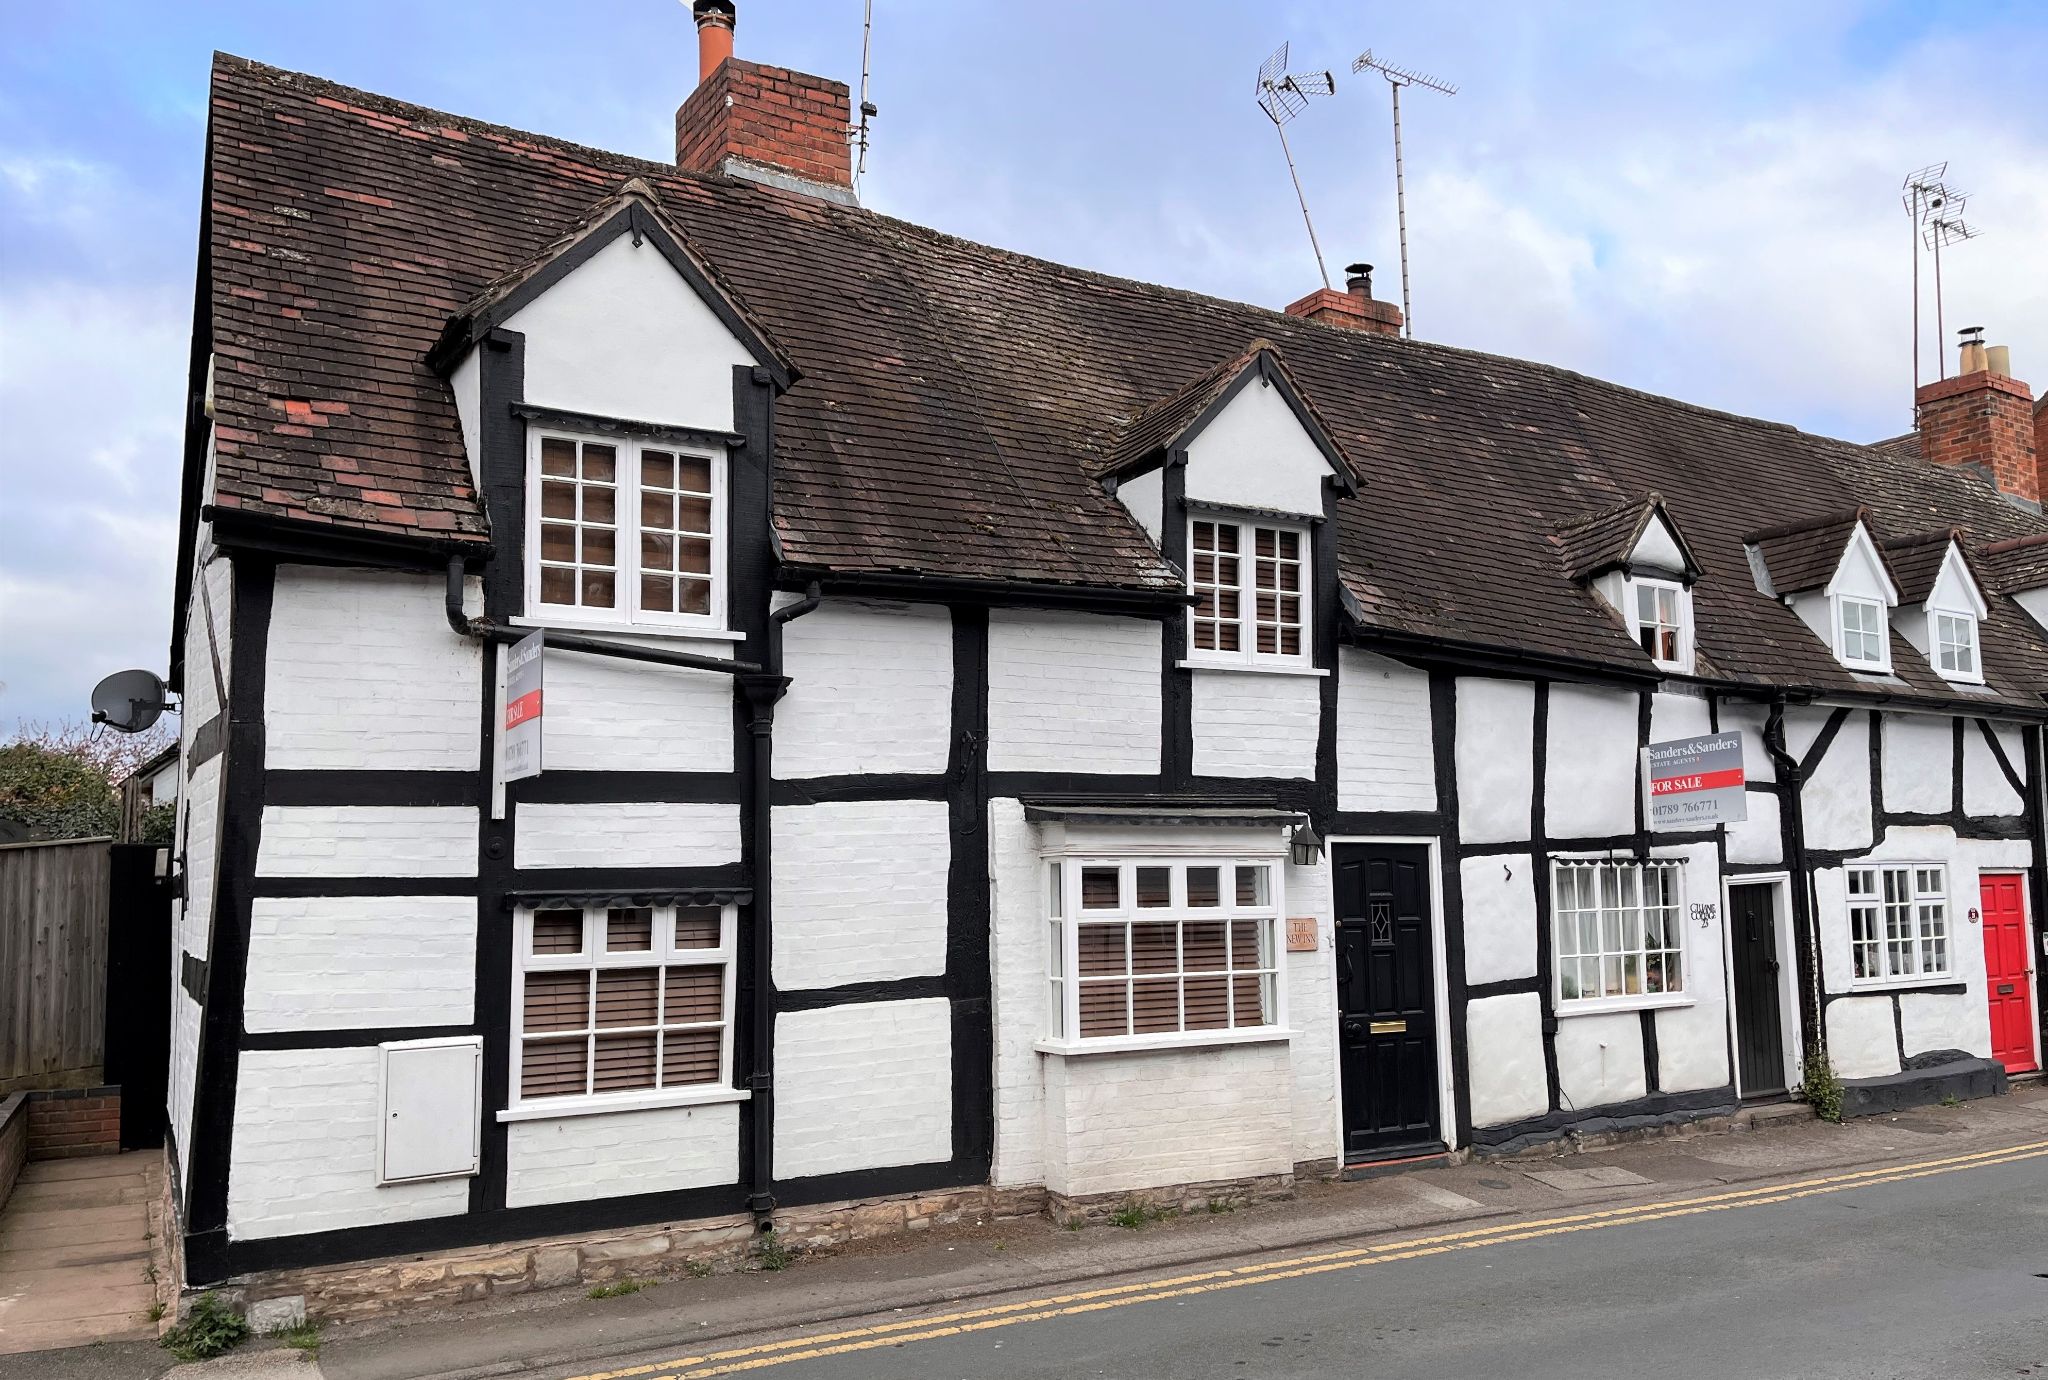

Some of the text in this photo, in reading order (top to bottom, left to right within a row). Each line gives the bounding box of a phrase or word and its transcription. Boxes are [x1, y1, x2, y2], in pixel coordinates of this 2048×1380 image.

[1650, 739, 1738, 760] Sanders&Sanders
[1673, 756, 1696, 766] AGENTS
[1651, 776, 1703, 793] FOR SALE
[1653, 799, 1718, 817] 01789 766771
[1293, 922, 1308, 932] THE
[1303, 933, 1316, 944] INN
